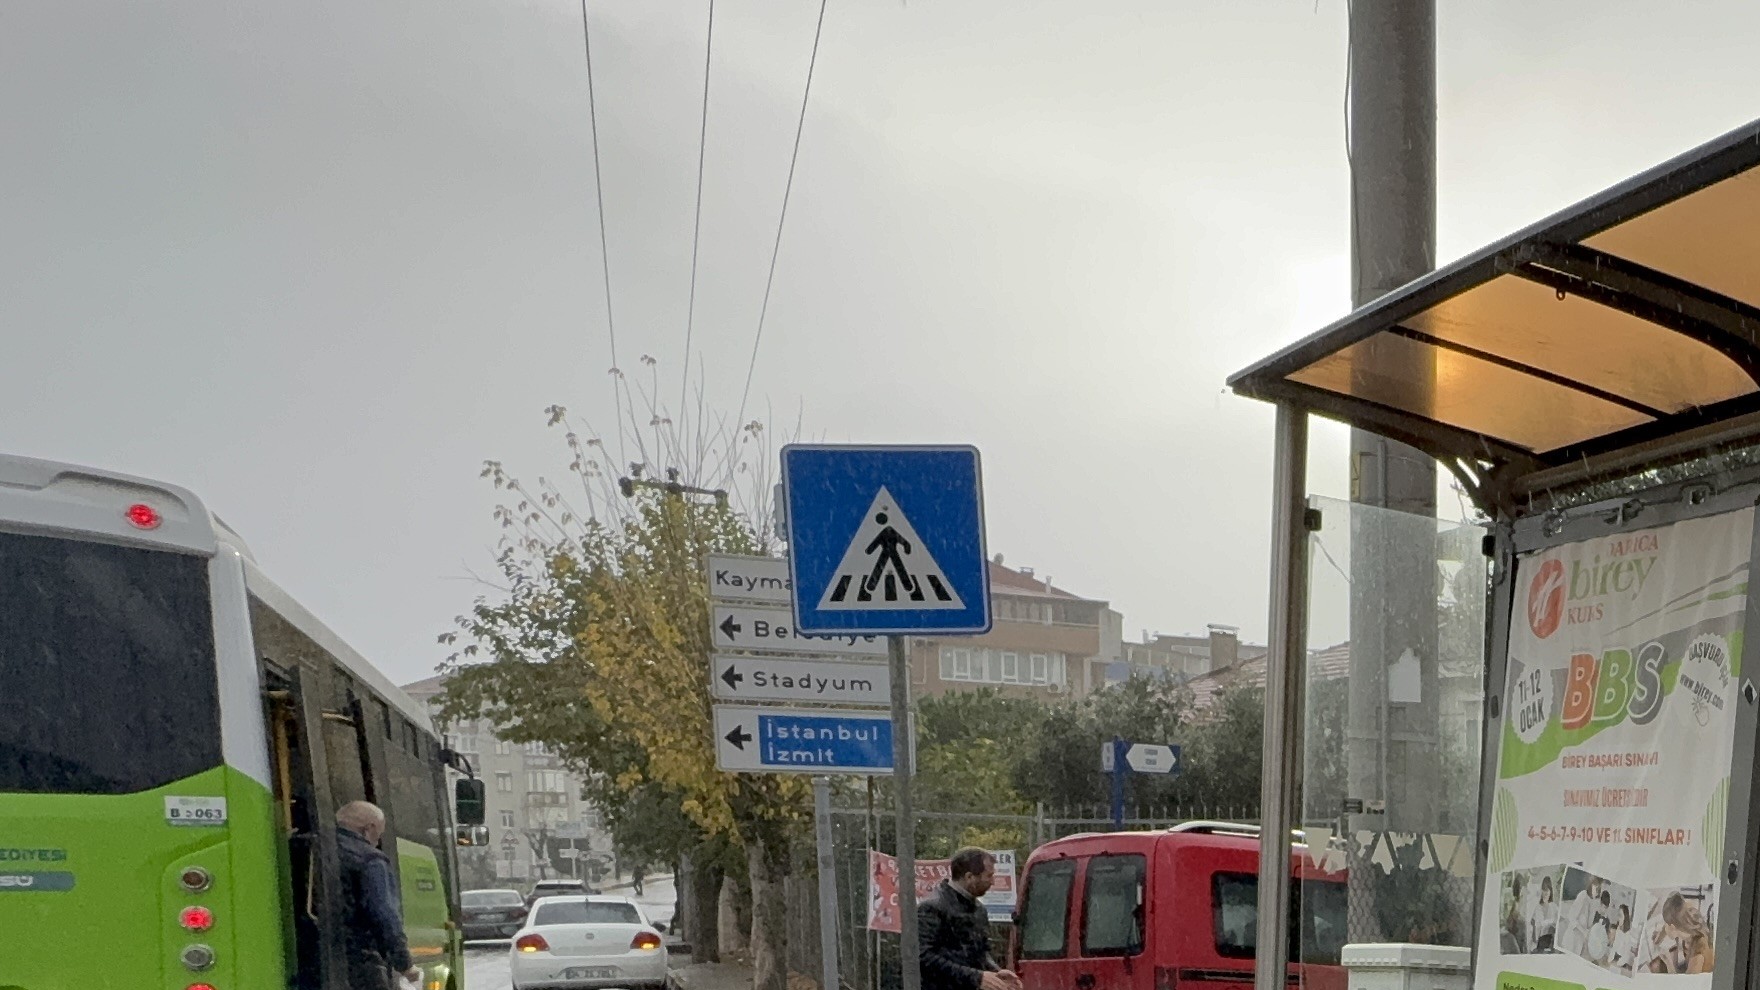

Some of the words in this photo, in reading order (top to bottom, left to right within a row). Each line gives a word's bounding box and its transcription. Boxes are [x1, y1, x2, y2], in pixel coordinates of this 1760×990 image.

[1567, 555, 1658, 601] birey
[753, 671, 872, 693] Stadyum
[1560, 642, 1668, 730] BBS
[767, 718, 878, 741] İstanbul
[1520, 697, 1545, 733] OCAK
[1596, 827, 1610, 843] VE
[1625, 827, 1685, 846] SINIFLAR
